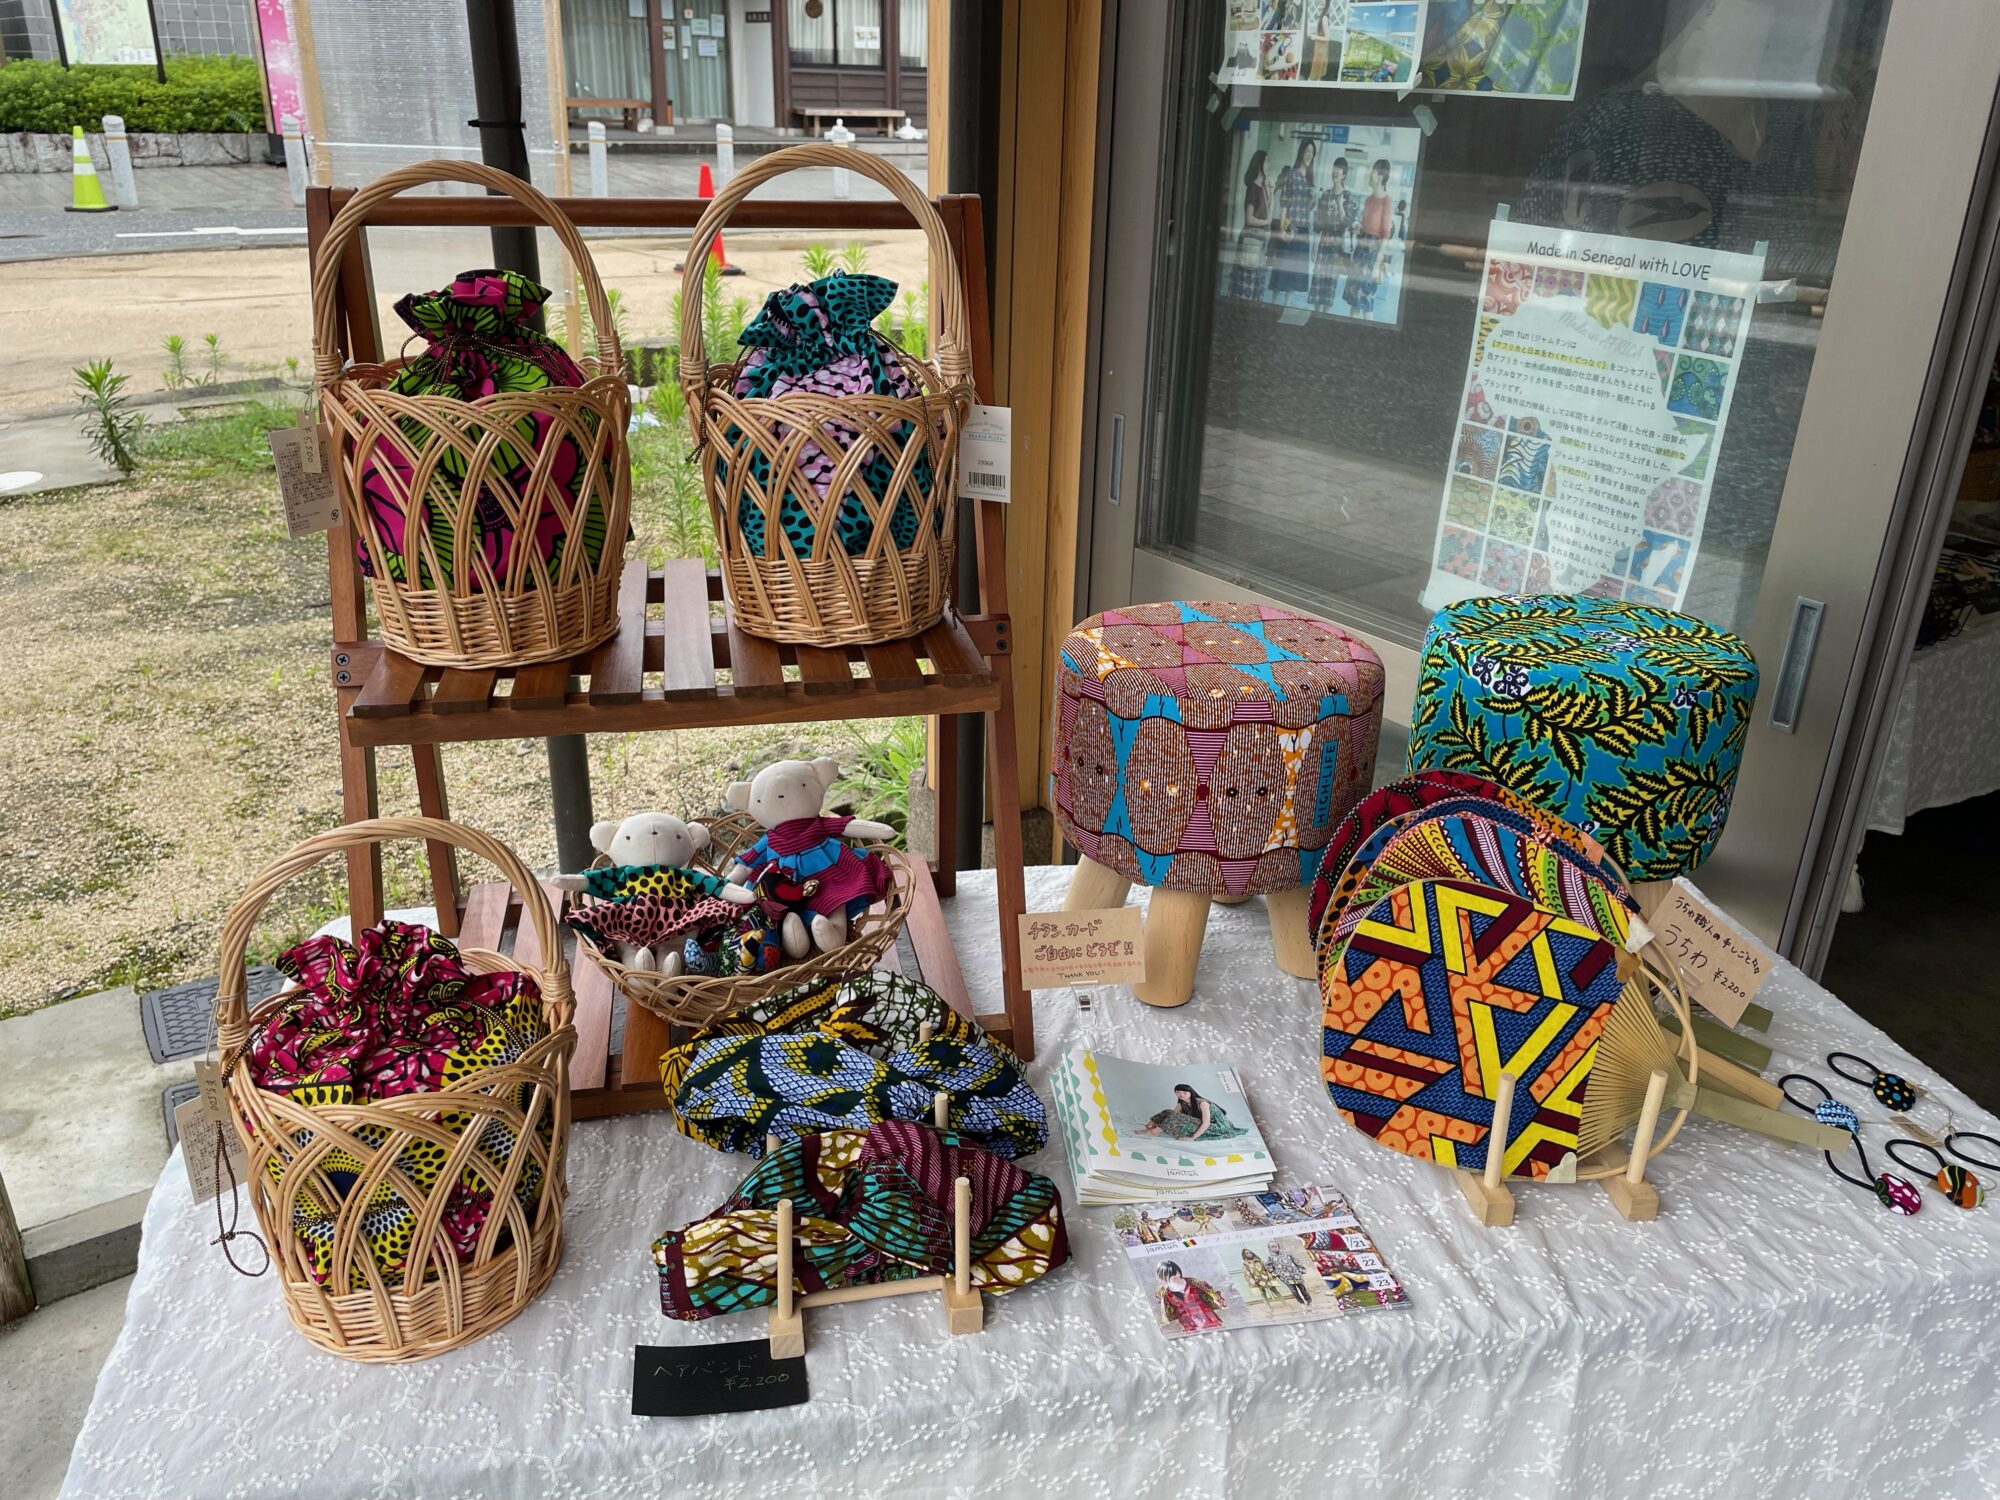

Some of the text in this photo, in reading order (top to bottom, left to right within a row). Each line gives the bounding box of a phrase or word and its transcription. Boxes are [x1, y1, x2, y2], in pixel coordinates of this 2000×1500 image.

[1526, 241, 1712, 281] Made in Senegal with LOVE
[1558, 309, 1588, 335] Made
[1500, 328, 1515, 338] jam
[1517, 330, 1531, 340] tun
[1665, 924, 1708, 969] うちわ
[1057, 972, 1083, 981] THANK
[1362, 1259, 1377, 1267] 22
[1377, 1279, 1391, 1287] 23
[653, 1354, 758, 1378] ヘアバンド
